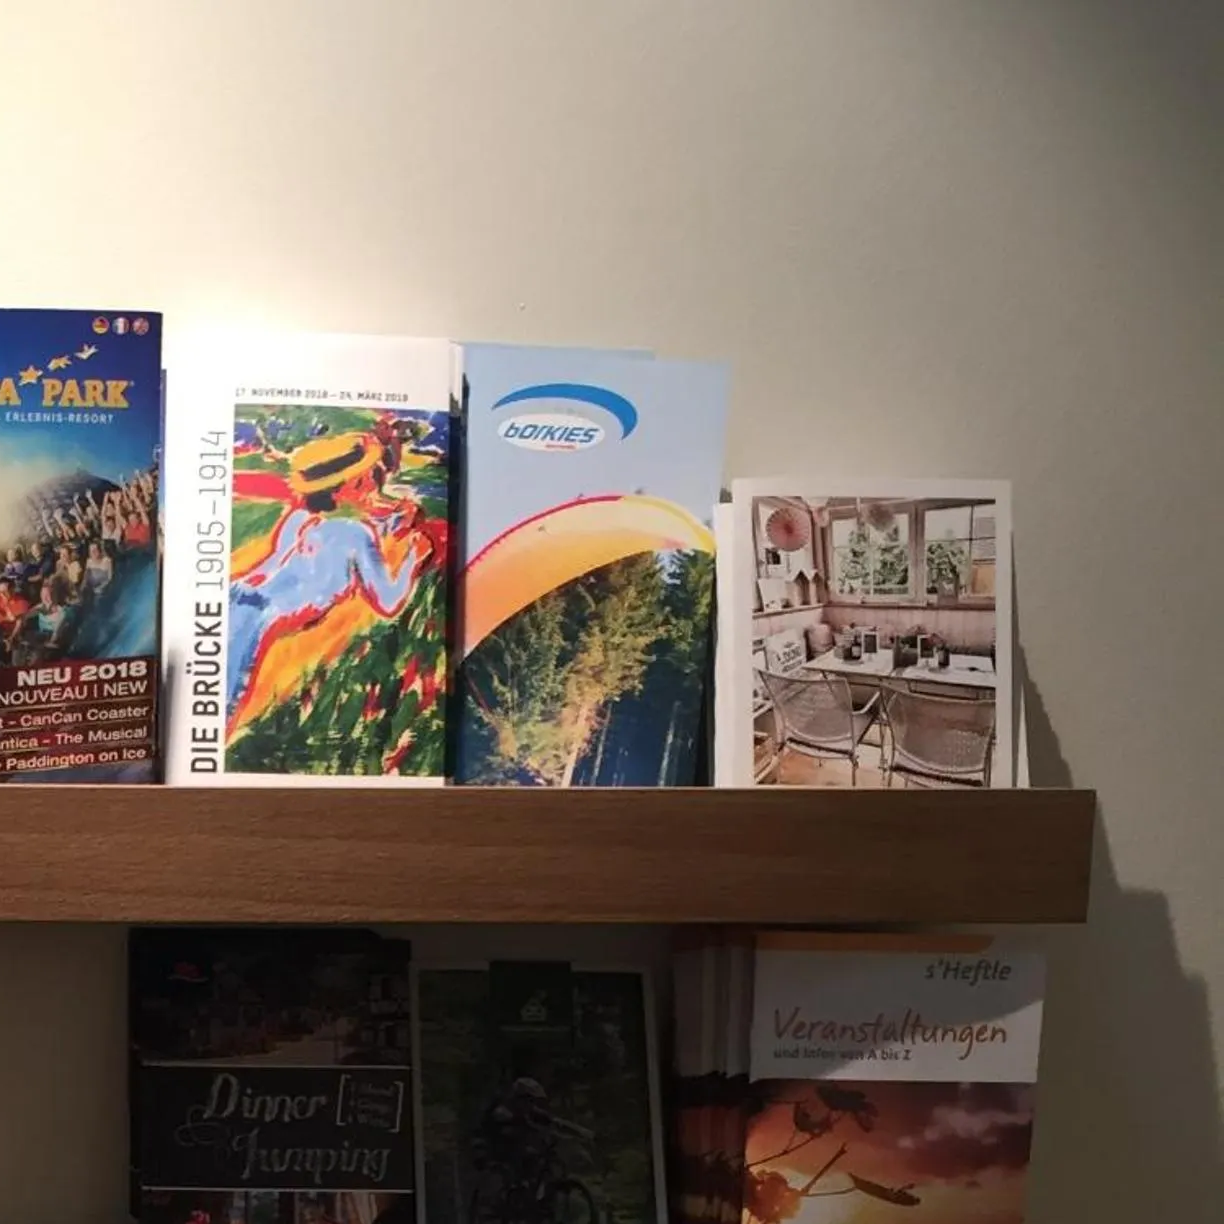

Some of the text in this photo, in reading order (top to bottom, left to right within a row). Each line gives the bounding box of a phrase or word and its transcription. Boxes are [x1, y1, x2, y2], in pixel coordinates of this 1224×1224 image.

[41, 377, 130, 409] PARK
[251, 388, 303, 398] NOVEMBER
[4, 411, 115, 425] ERLEBNIS-RESORT
[16, 660, 148, 688] NEU 2018
[184, 601, 224, 719] BRÜCKE
[102, 679, 149, 698] NEW
[19, 710, 83, 728] CanCan
[85, 704, 150, 723] Coaster
[54, 730, 84, 746] The
[87, 725, 149, 743] Musical
[5, 747, 147, 772] Paddington on Ice
[190, 727, 219, 775] DIE
[925, 958, 1013, 986] s'Heftle
[774, 1007, 1008, 1061] Veranstaltungen
[203, 1072, 327, 1123] Dinner
[232, 1126, 392, 1185] Jumping
